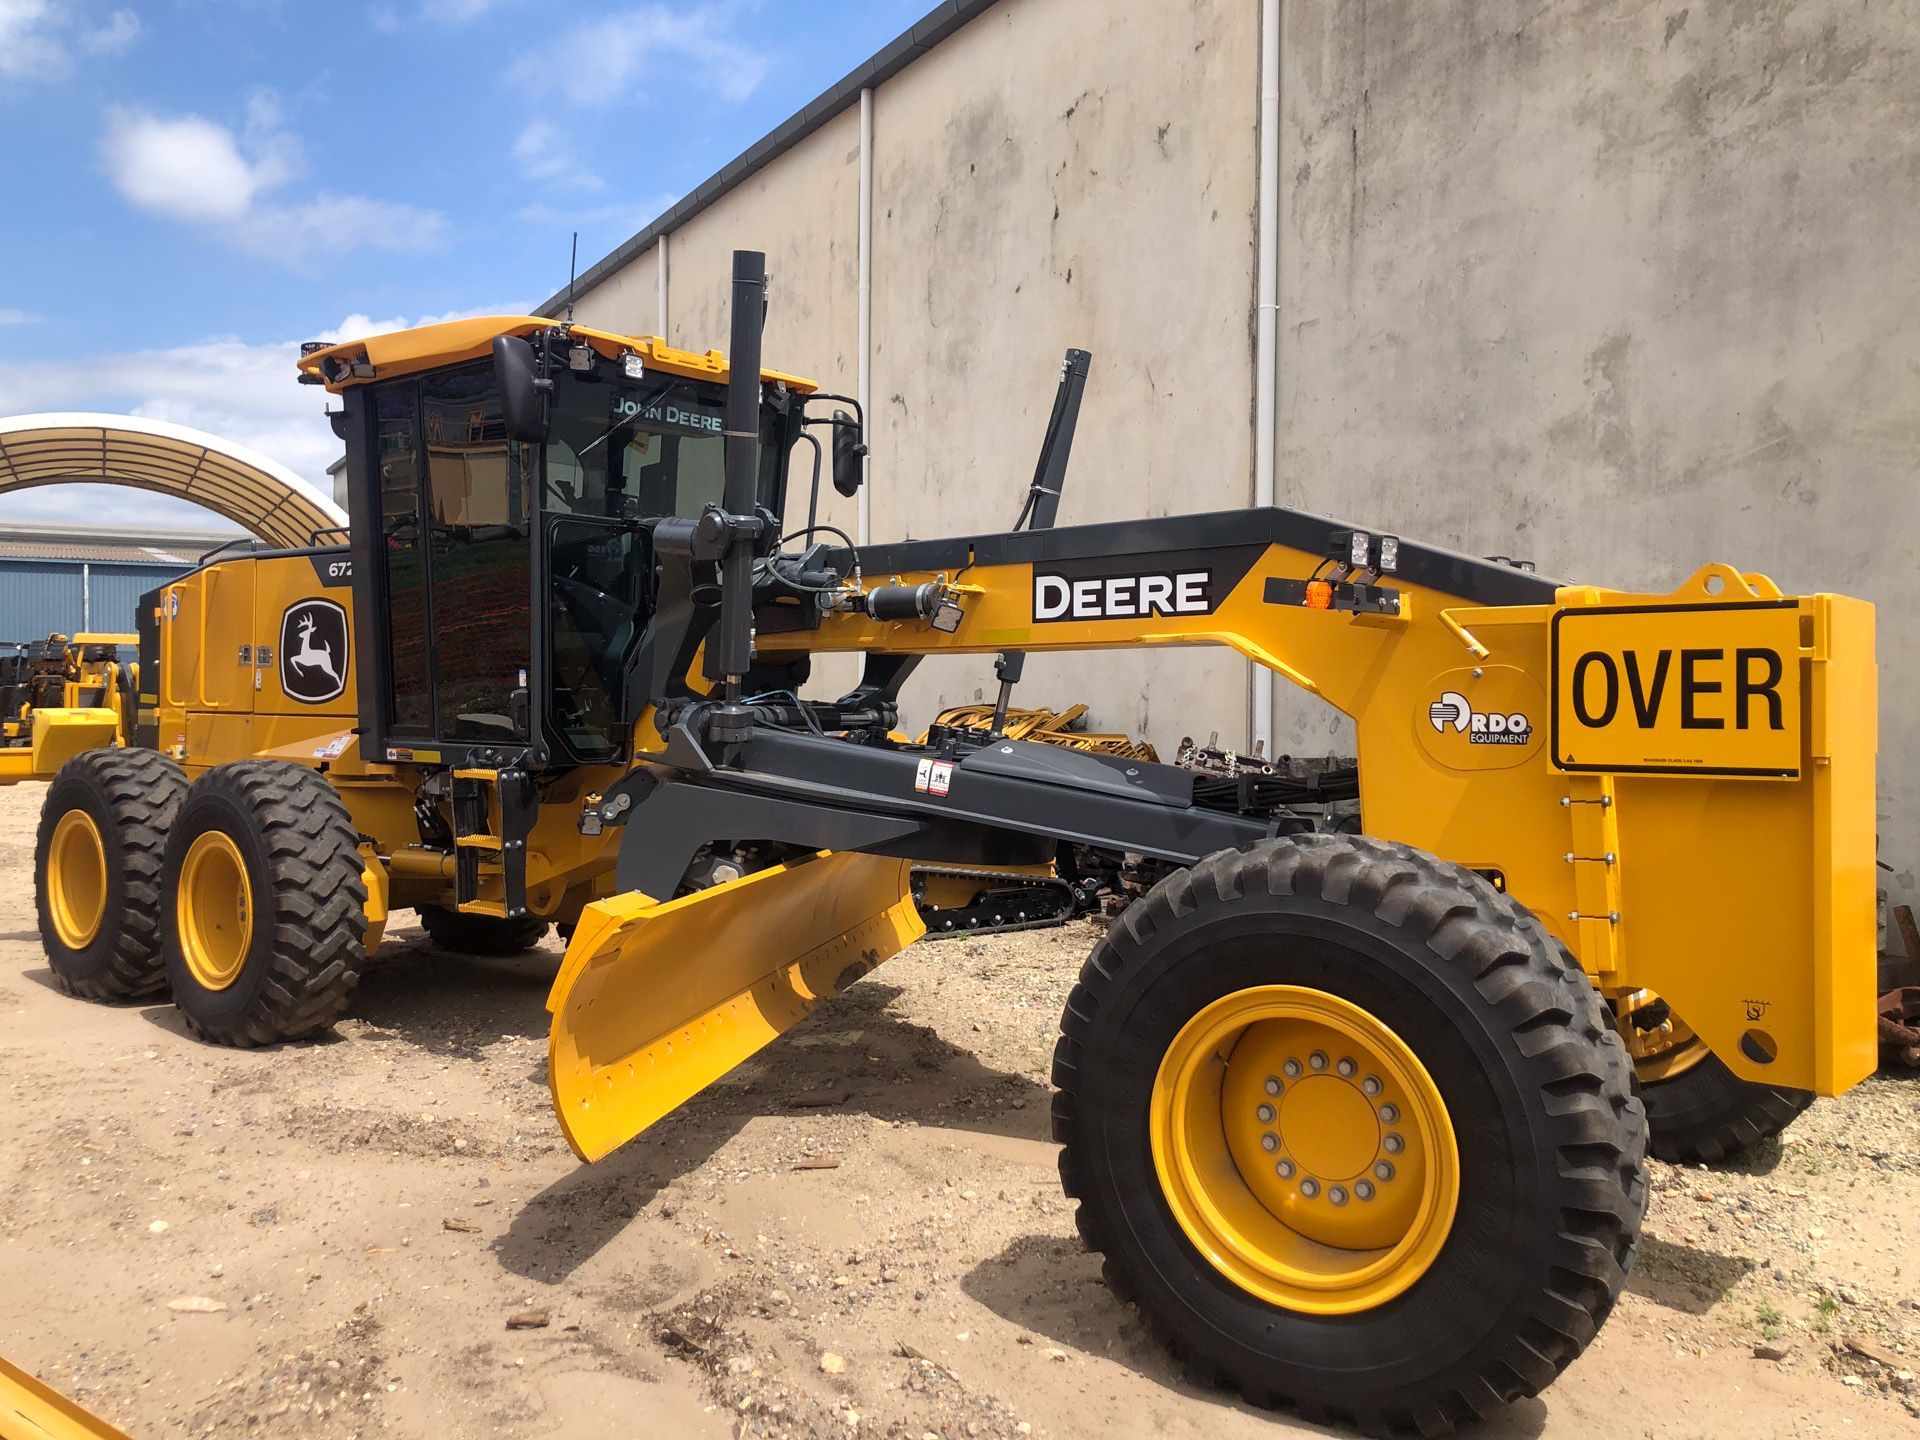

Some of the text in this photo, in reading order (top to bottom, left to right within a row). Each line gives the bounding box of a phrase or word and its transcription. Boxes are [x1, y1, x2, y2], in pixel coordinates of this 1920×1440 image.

[666, 406, 722, 431] DEERE
[1035, 572, 1208, 619] DEERE
[1572, 648, 1785, 730] OVER
[1471, 733, 1527, 744] EQUIPMENT
